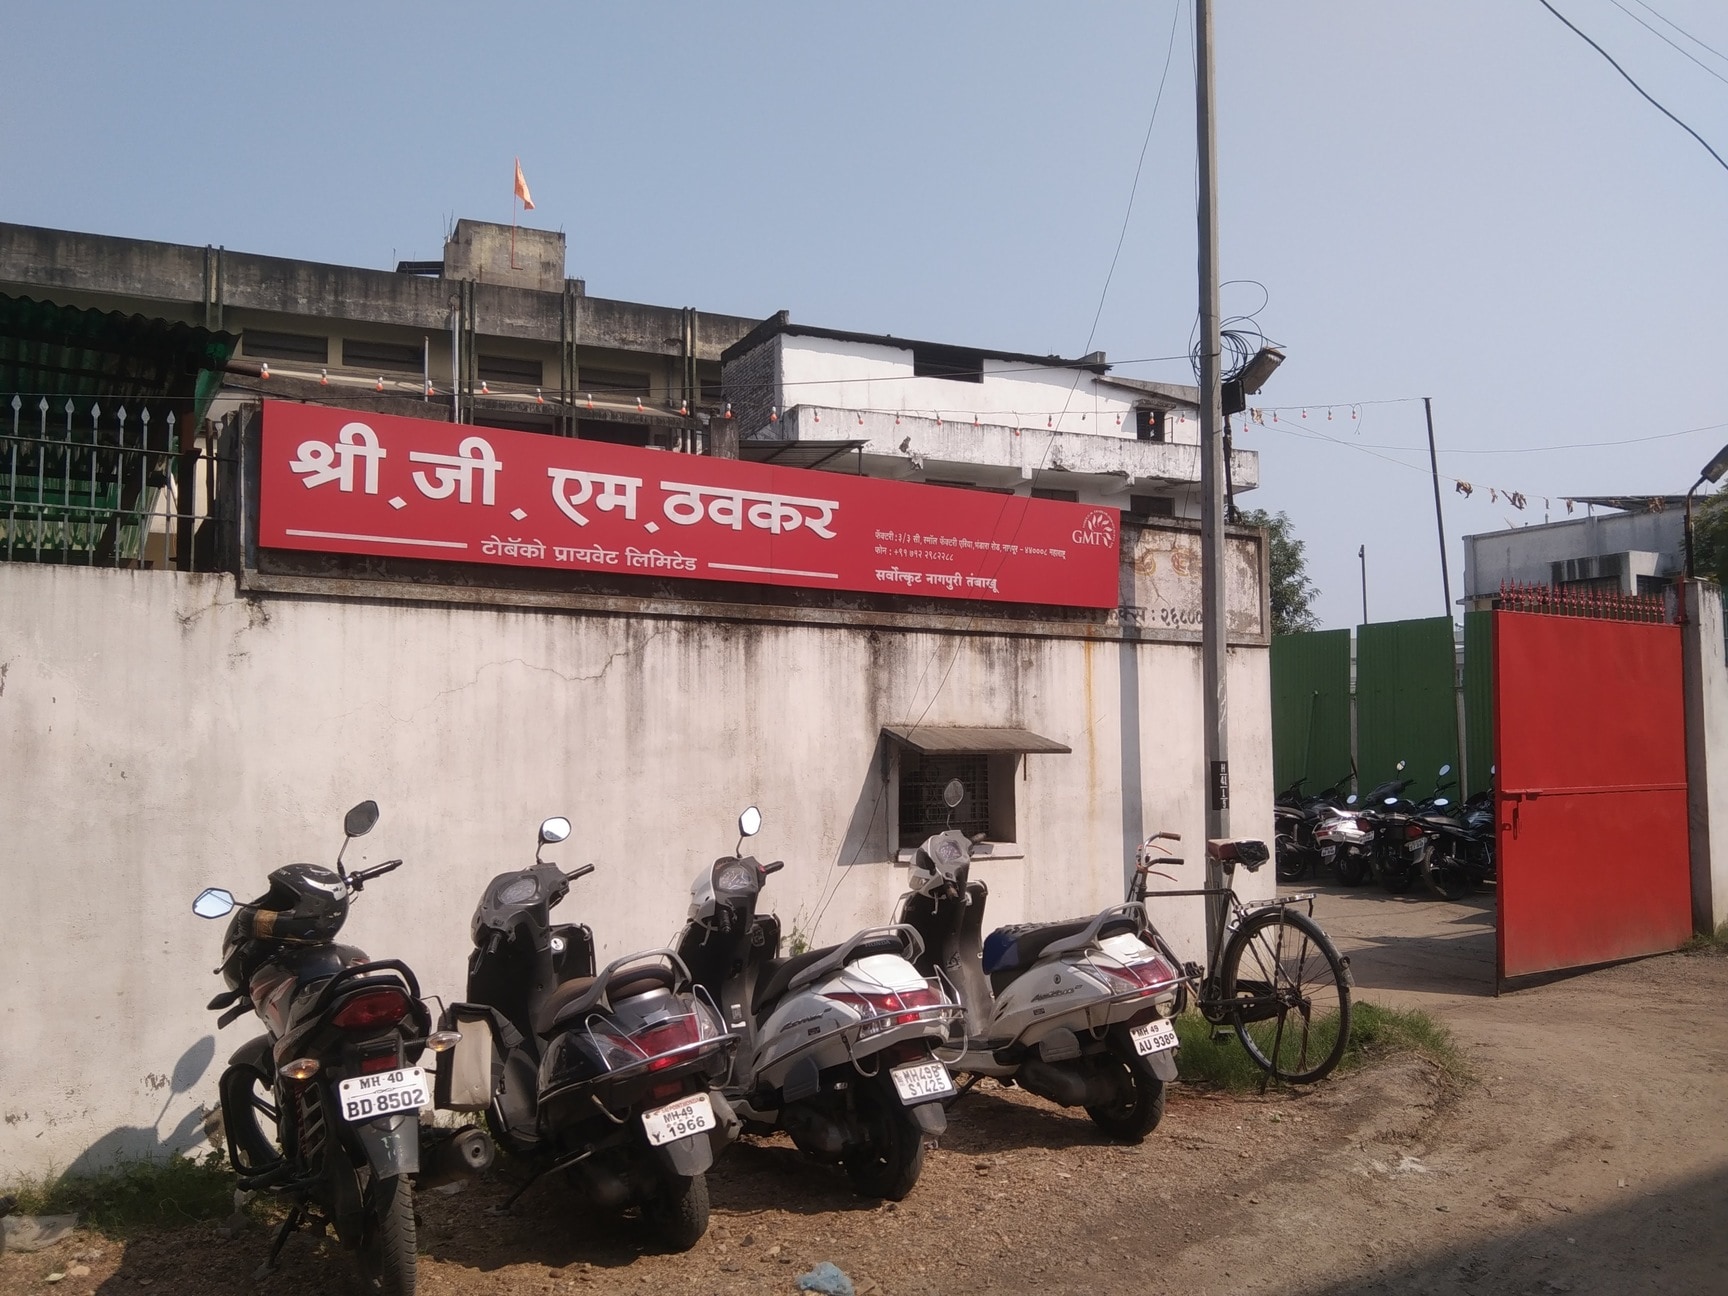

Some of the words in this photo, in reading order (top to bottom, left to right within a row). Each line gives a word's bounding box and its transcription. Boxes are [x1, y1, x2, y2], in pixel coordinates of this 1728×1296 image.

[660, 480, 840, 540] ठवकर
[1072, 530, 1102, 545] GMT
[480, 535, 546, 560] टोबॅको
[553, 544, 619, 566] प्रायवेट
[625, 546, 698, 572] लिमिटेड
[925, 572, 963, 590] नागपुरी
[966, 573, 1000, 593] तंबाखू
[1136, 1028, 1149, 1037] MH
[1150, 1024, 1159, 1033] 49
[1139, 1040, 1152, 1053] AU
[663, 1106, 694, 1123] MH-49
[669, 1116, 706, 1138] 1966
